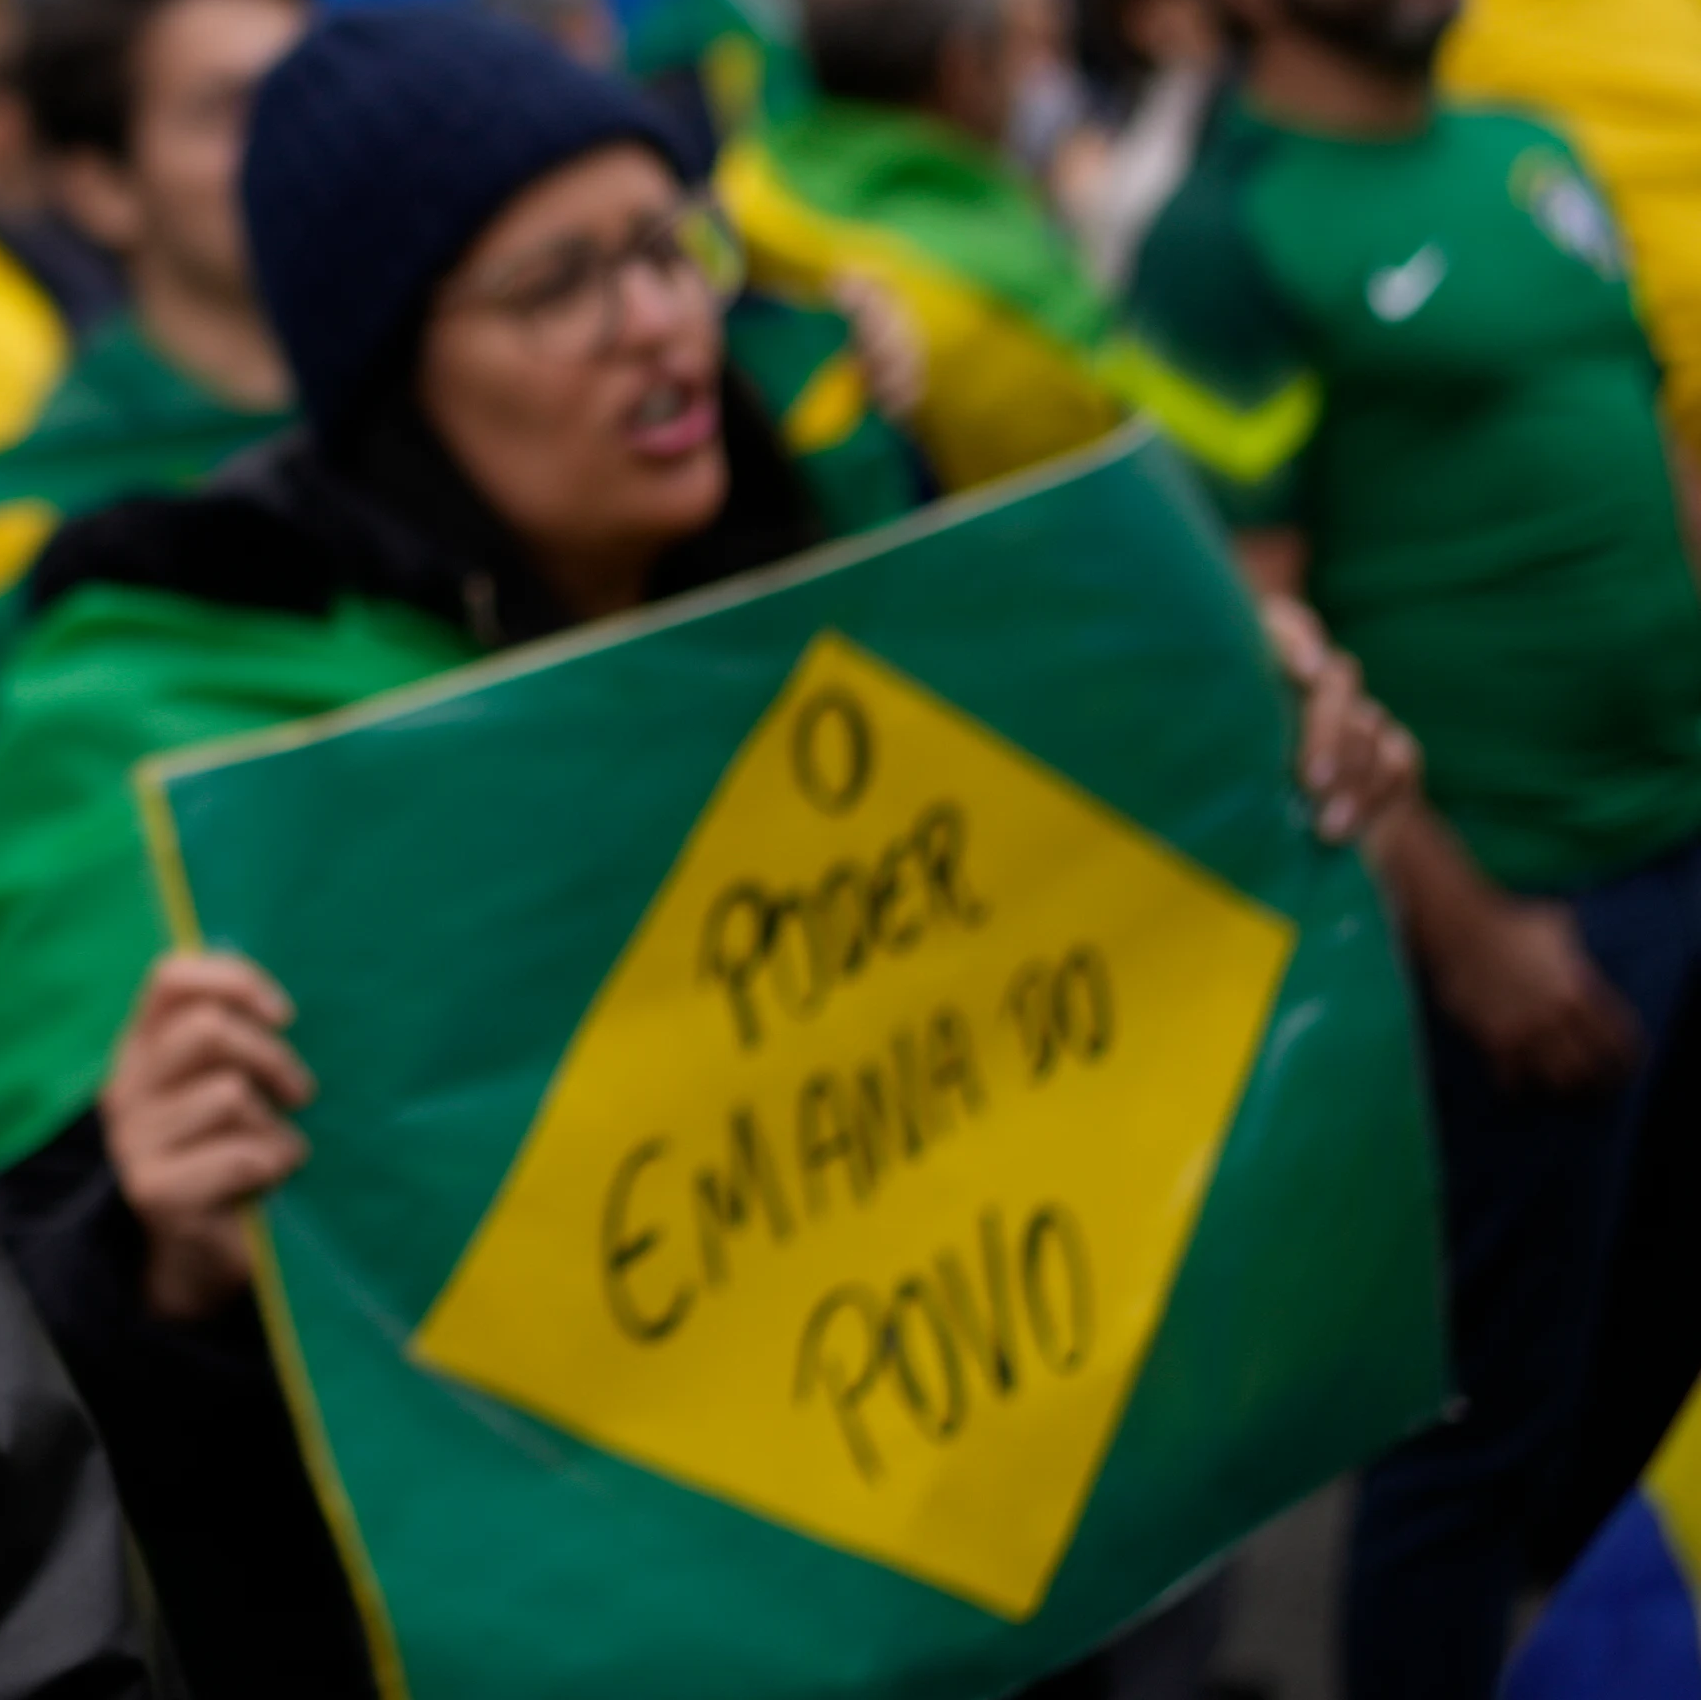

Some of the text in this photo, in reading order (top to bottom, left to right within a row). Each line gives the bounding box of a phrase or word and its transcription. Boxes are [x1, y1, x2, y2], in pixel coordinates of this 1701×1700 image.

[791, 685, 876, 814] O
[698, 802, 988, 1050] PODER
[603, 943, 1116, 1347] EMANA DO
[793, 1202, 1096, 1484] POVO
